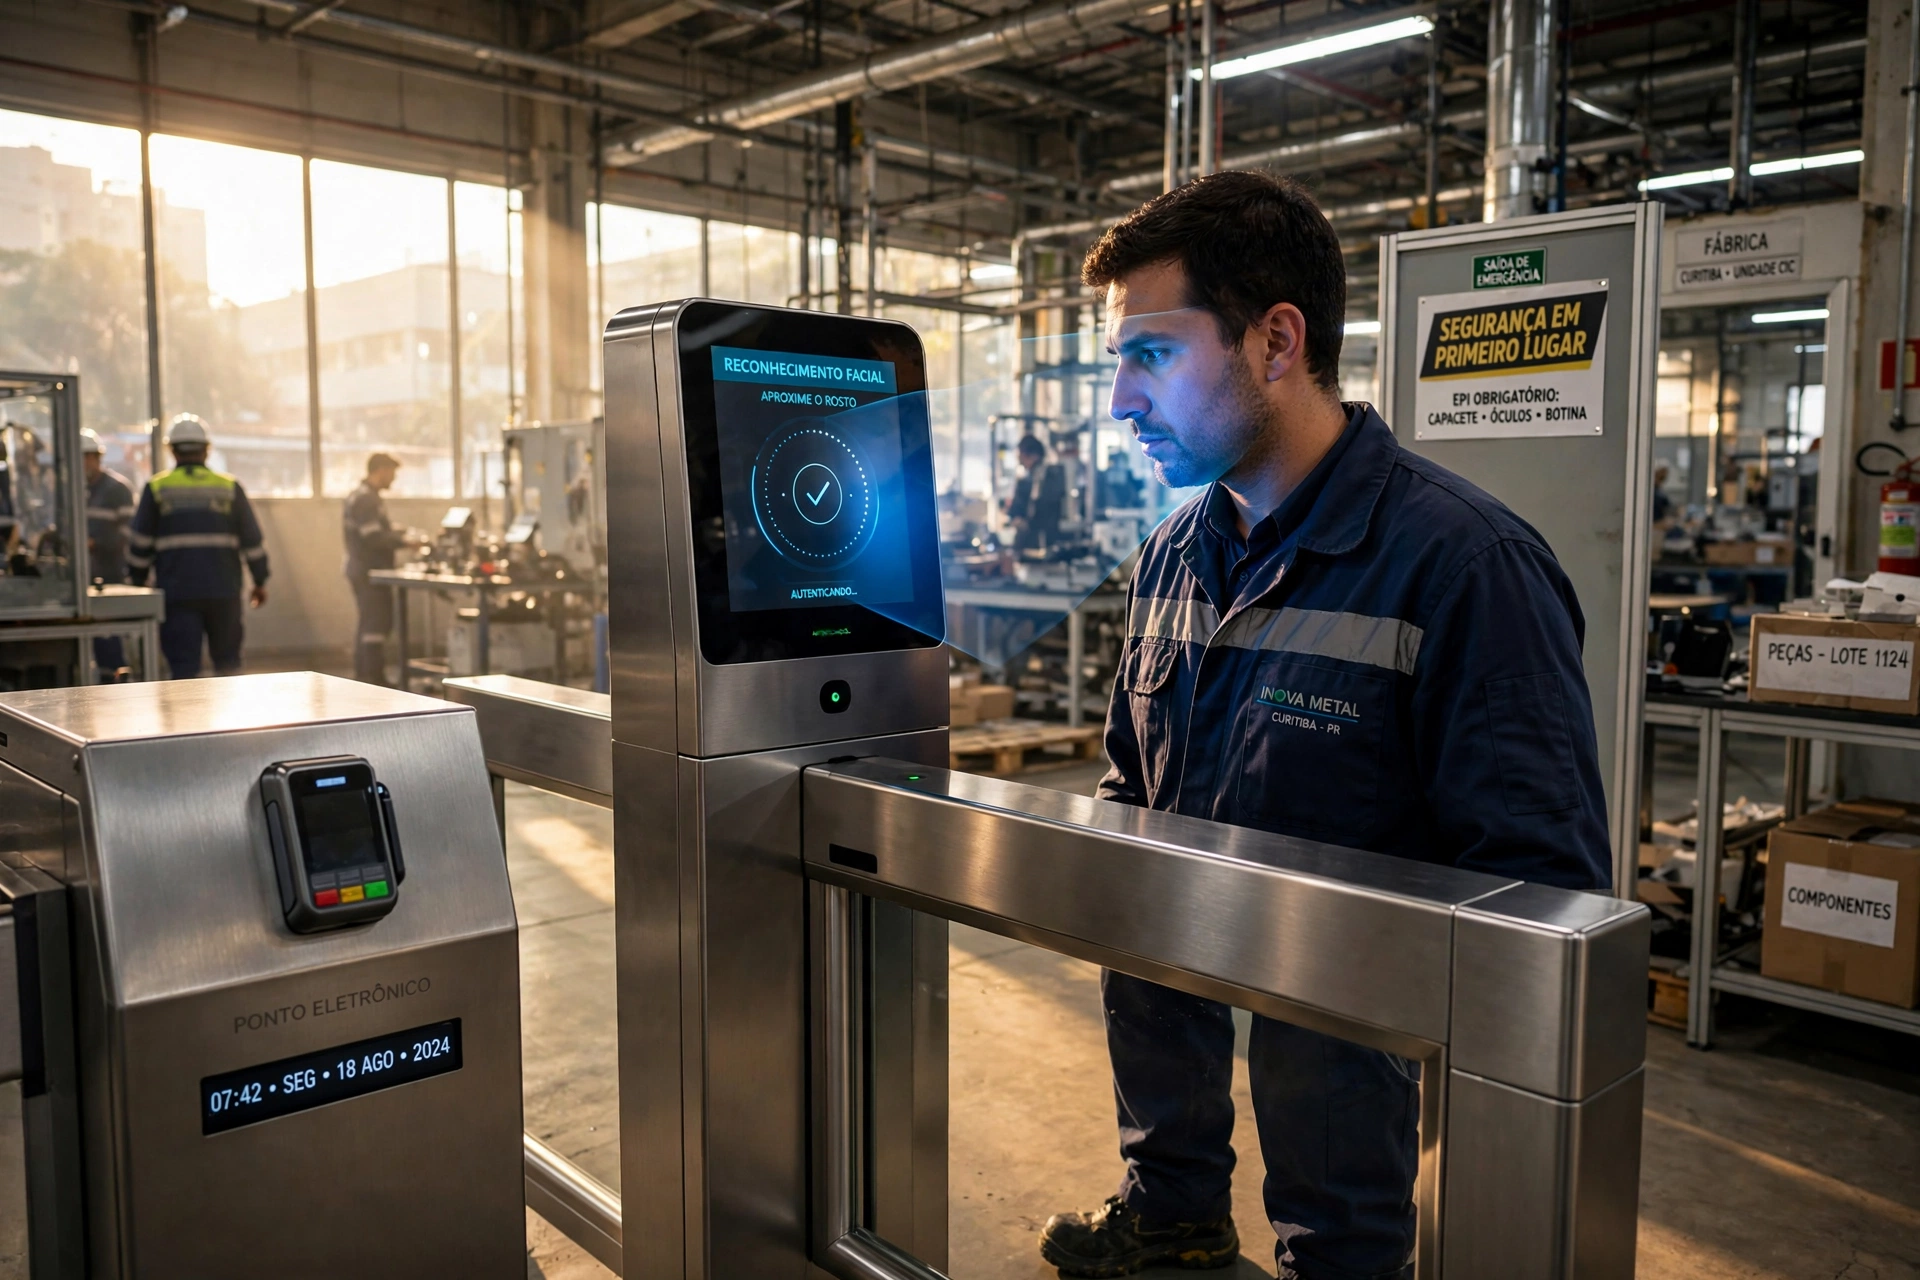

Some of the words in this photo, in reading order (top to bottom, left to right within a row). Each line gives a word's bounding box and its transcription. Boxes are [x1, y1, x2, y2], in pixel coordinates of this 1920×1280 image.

[1704, 231, 1768, 255] FÁBRICA
[1483, 256, 1514, 272] SAÍDA
[1515, 255, 1530, 268] DE
[1439, 306, 1546, 342] SEGURANÇA
[1551, 301, 1581, 328] EM
[1434, 338, 1520, 369] PRIMEIRO
[1523, 330, 1587, 360] LUGAR
[723, 357, 843, 380] RECONHECIMENTO
[846, 368, 885, 384] FACIAL
[761, 390, 812, 405] APROXIME
[815, 394, 823, 405] O
[825, 395, 857, 408] ROSTO
[1453, 391, 1470, 406] EPI
[1473, 385, 1560, 405] OBRIGATÓRIO:
[1428, 411, 1478, 425] CAPACETE
[1490, 407, 1532, 424] ÓCULOS
[1545, 406, 1587, 421] BOTINA
[1768, 643, 1813, 666] PEÇAS
[1830, 646, 1868, 665] LOTE
[1875, 648, 1909, 669] 1124
[1260, 686, 1305, 707] INOVA
[1309, 695, 1360, 717] METAL
[1271, 712, 1317, 731] CURITIBA
[1327, 723, 1340, 735] PR
[1787, 886, 1892, 921] COMPONENTES
[233, 1004, 307, 1034] PONTO
[312, 977, 432, 1017] ELETRÔNICO
[210, 1082, 263, 1113] 07:42
[282, 1069, 316, 1094] SEG
[336, 1059, 356, 1080] 18
[361, 1050, 395, 1075] AGO
[412, 1036, 451, 1062] 2024
